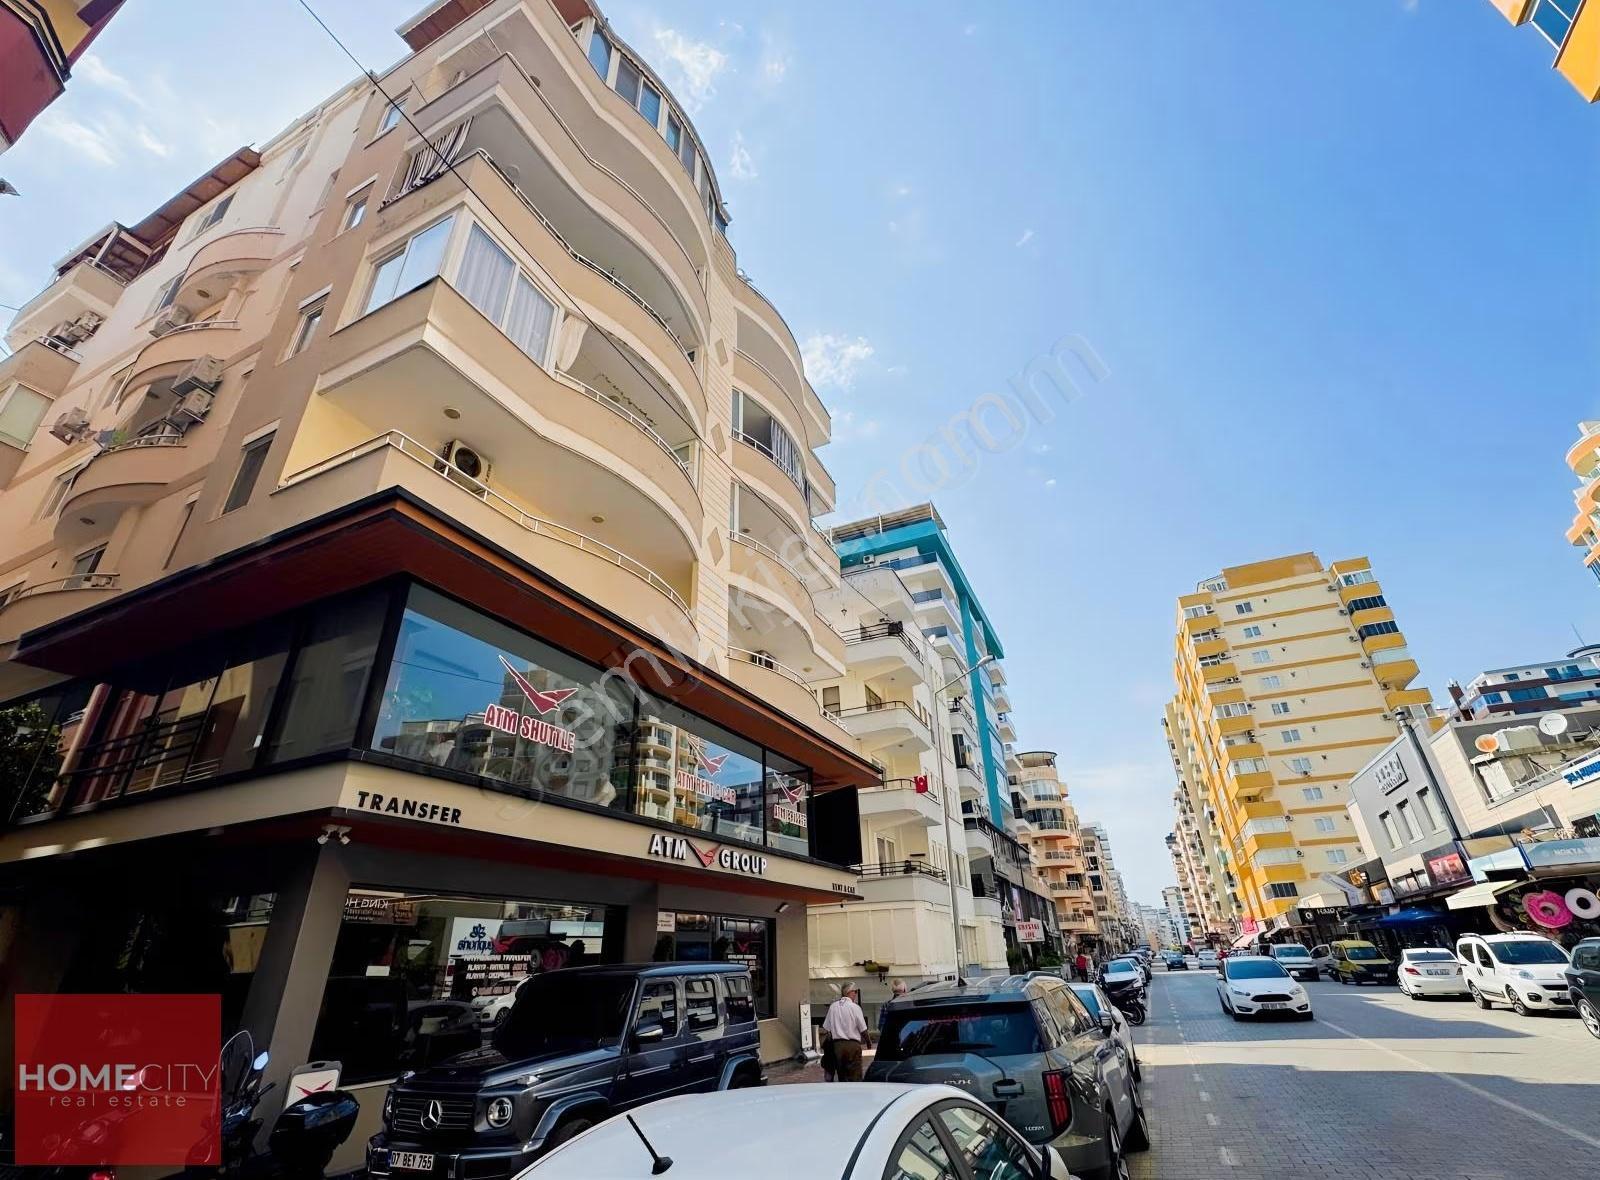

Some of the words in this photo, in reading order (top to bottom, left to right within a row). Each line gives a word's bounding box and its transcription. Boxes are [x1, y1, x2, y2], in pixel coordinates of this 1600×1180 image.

[484, 704, 518, 734] ATM
[520, 716, 576, 753] SHUTTLE
[676, 770, 696, 791] ATM
[358, 791, 462, 824] TRANSFER
[650, 833, 687, 860] ATM
[720, 849, 768, 874] GROUP
[402, 1153, 417, 1167] BEY
[418, 1155, 433, 1169] 755
